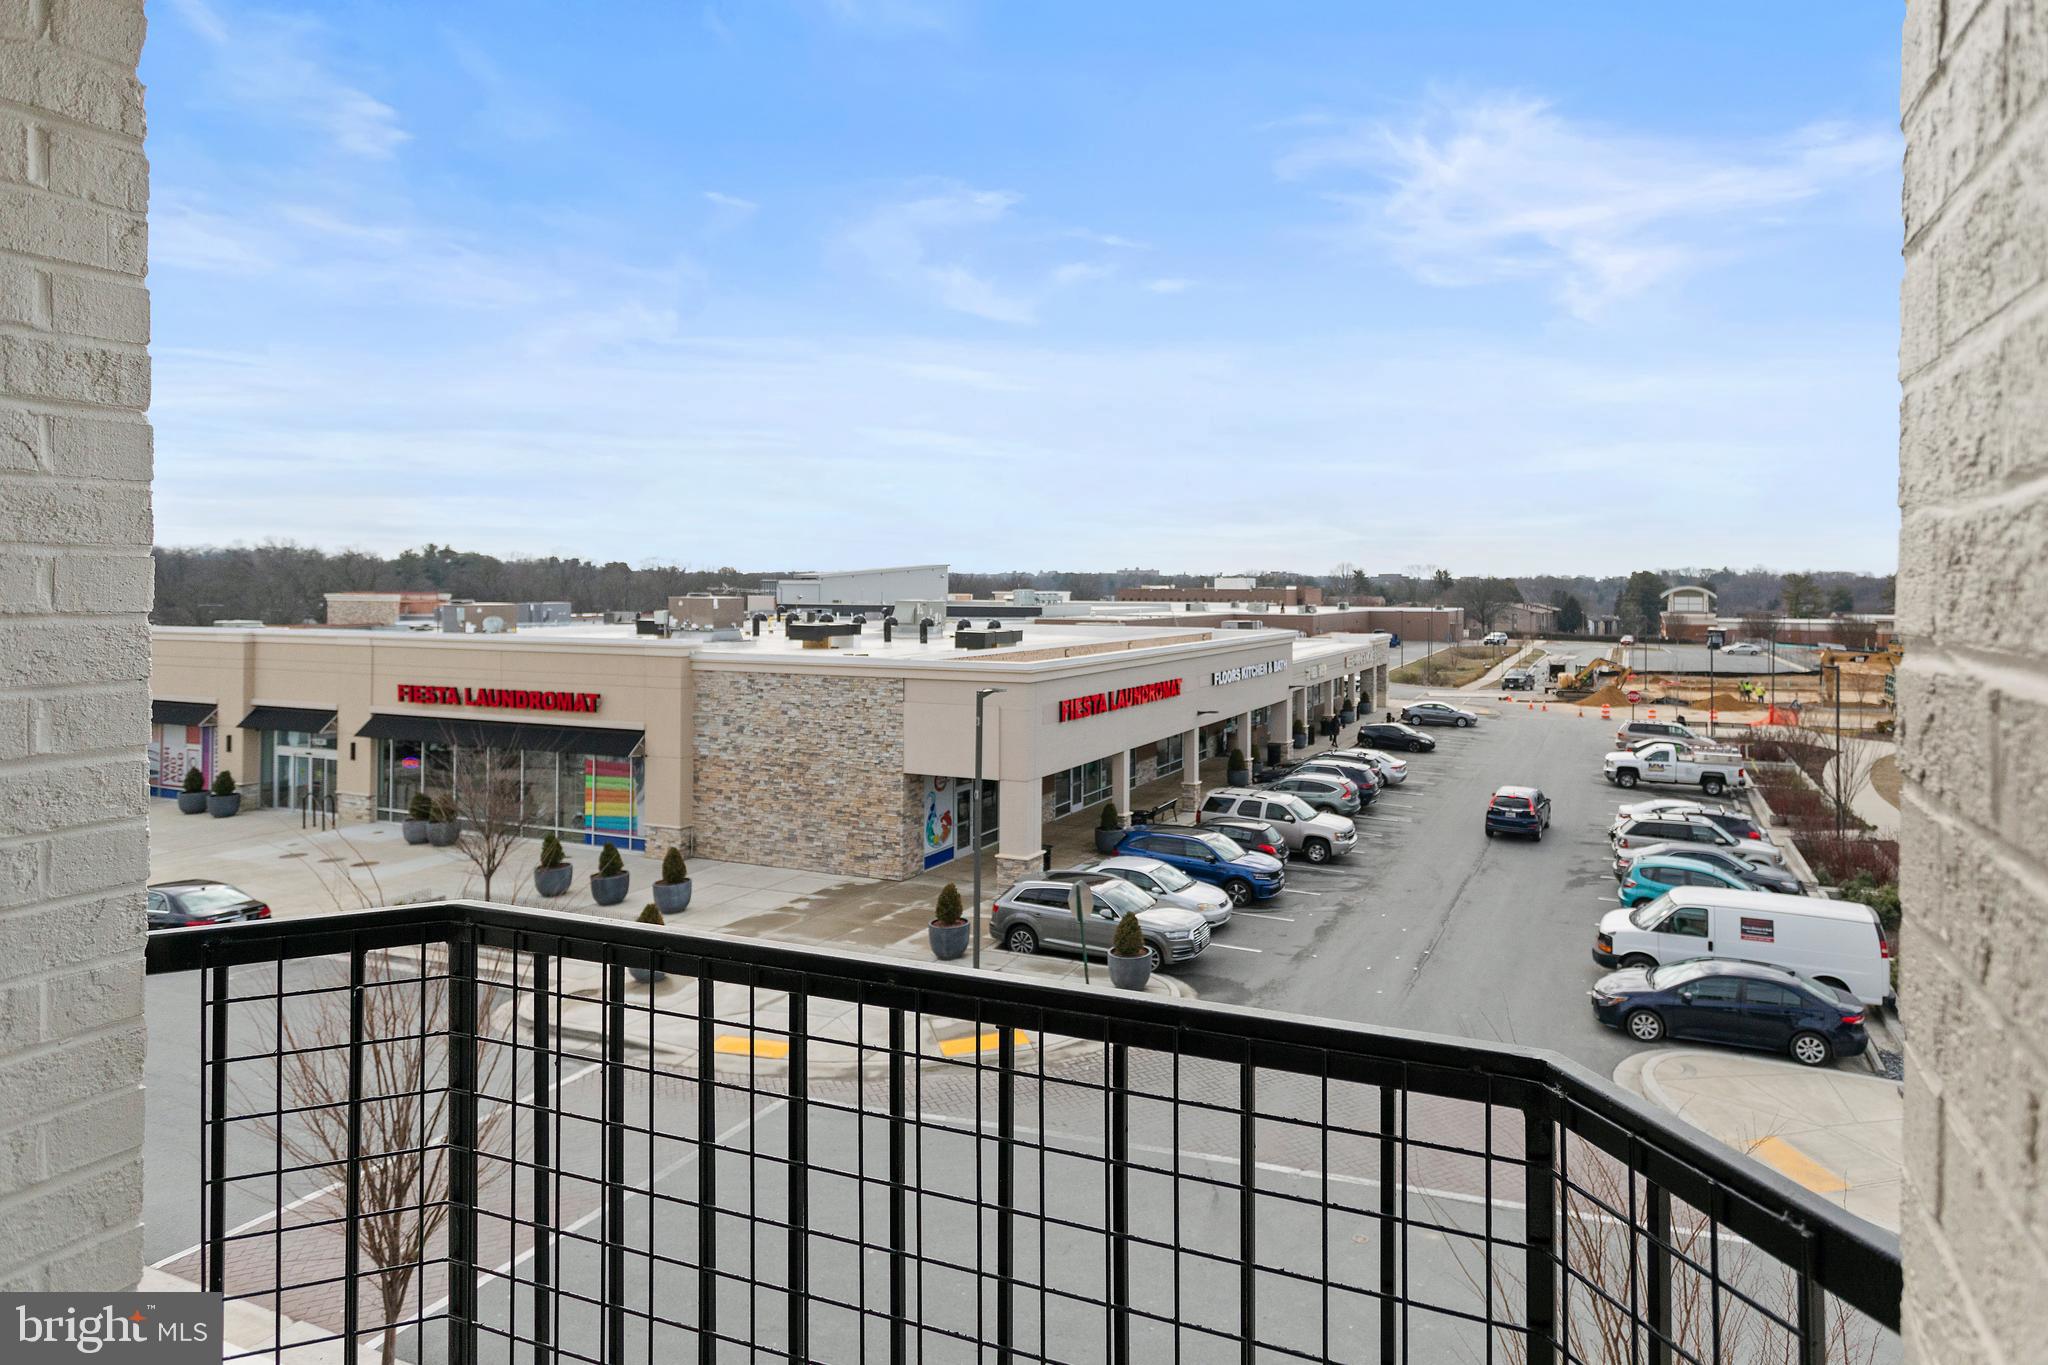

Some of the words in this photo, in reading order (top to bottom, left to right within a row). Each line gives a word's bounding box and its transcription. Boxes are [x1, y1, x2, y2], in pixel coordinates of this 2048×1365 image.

[1212, 669, 1240, 686] FLOORS
[1240, 663, 1267, 680] KITCHEN
[1267, 661, 1272, 674] &
[397, 684, 462, 705] FIESTA
[464, 687, 601, 713] LAUNDROMAT
[1060, 692, 1108, 722] FIESTA
[1108, 678, 1183, 710] LAUNDROMAT
